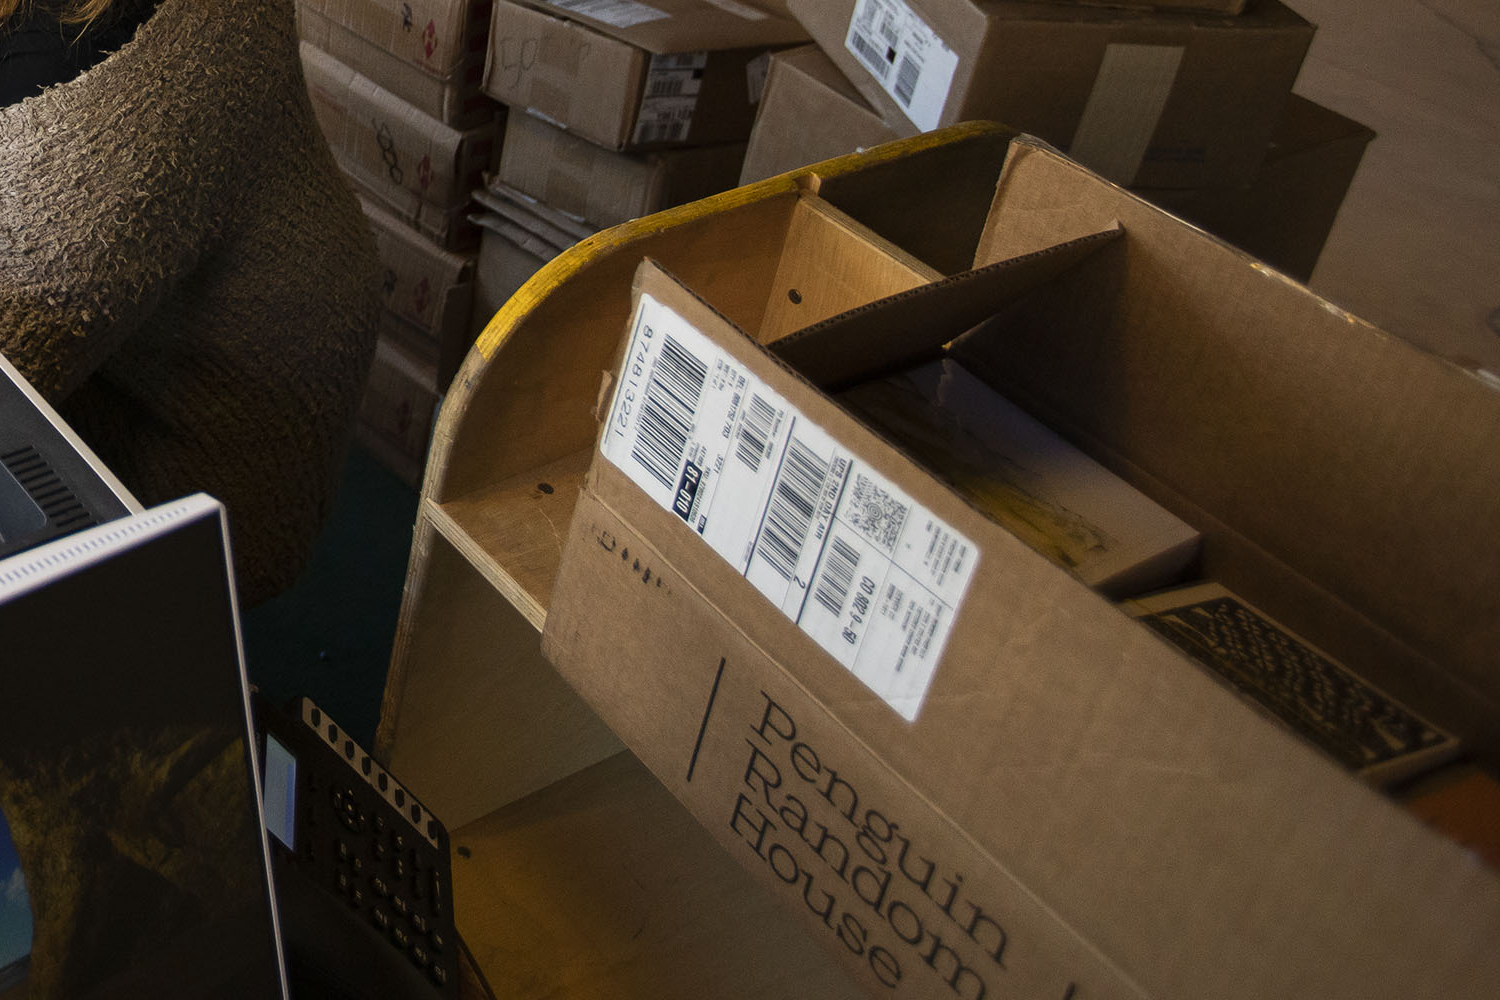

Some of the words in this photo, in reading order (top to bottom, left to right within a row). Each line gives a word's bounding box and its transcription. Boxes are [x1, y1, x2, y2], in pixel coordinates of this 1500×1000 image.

[613, 323, 655, 439] 874813221
[675, 463, 699, 514] 81-010
[813, 520, 826, 541] AIR
[819, 499, 833, 522] DAY
[744, 738, 988, 1000] Random
[750, 690, 1010, 970] Penguin
[730, 793, 904, 989] House
